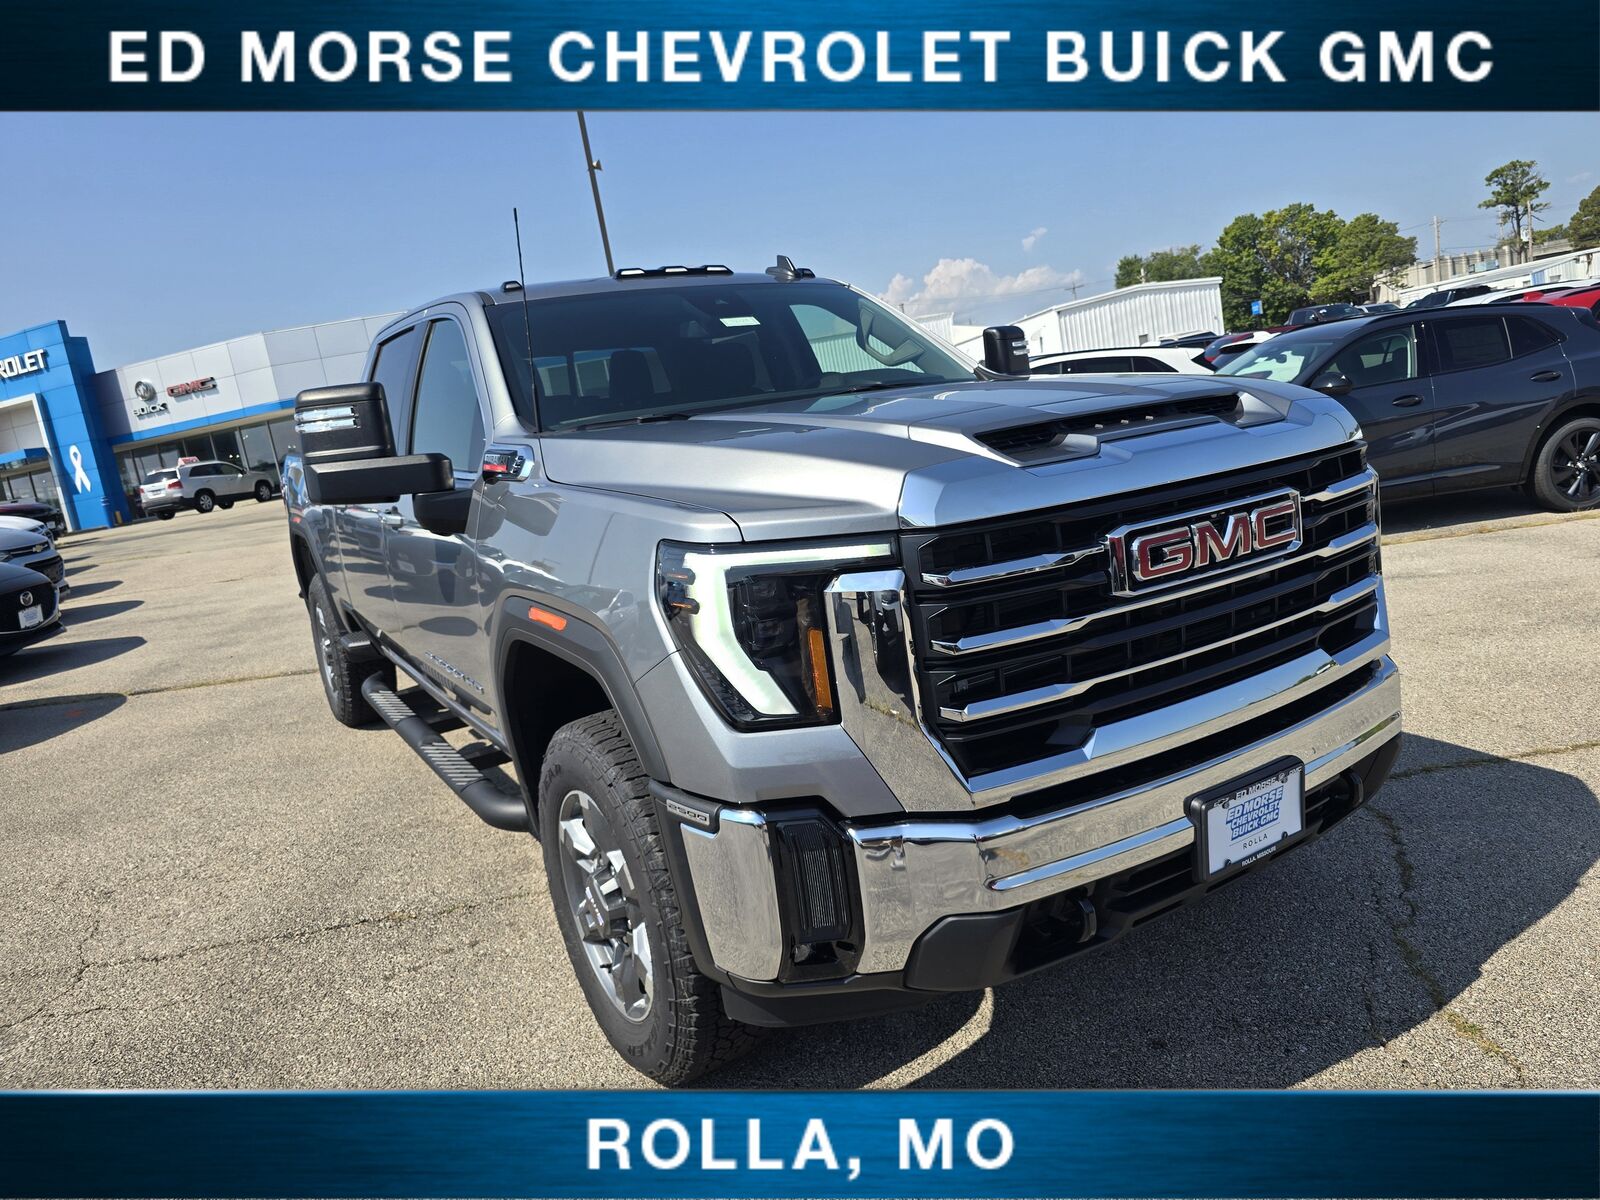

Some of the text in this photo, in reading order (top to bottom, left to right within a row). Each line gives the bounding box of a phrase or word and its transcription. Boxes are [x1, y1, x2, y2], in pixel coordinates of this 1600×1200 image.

[167, 377, 217, 397] GMC
[1132, 500, 1297, 581] GMC
[1236, 789, 1247, 800] ED
[1248, 777, 1277, 796] MORSE
[668, 803, 707, 821] 2500
[1227, 786, 1284, 823] ED MORSE
[1242, 833, 1268, 850] ROLLA
